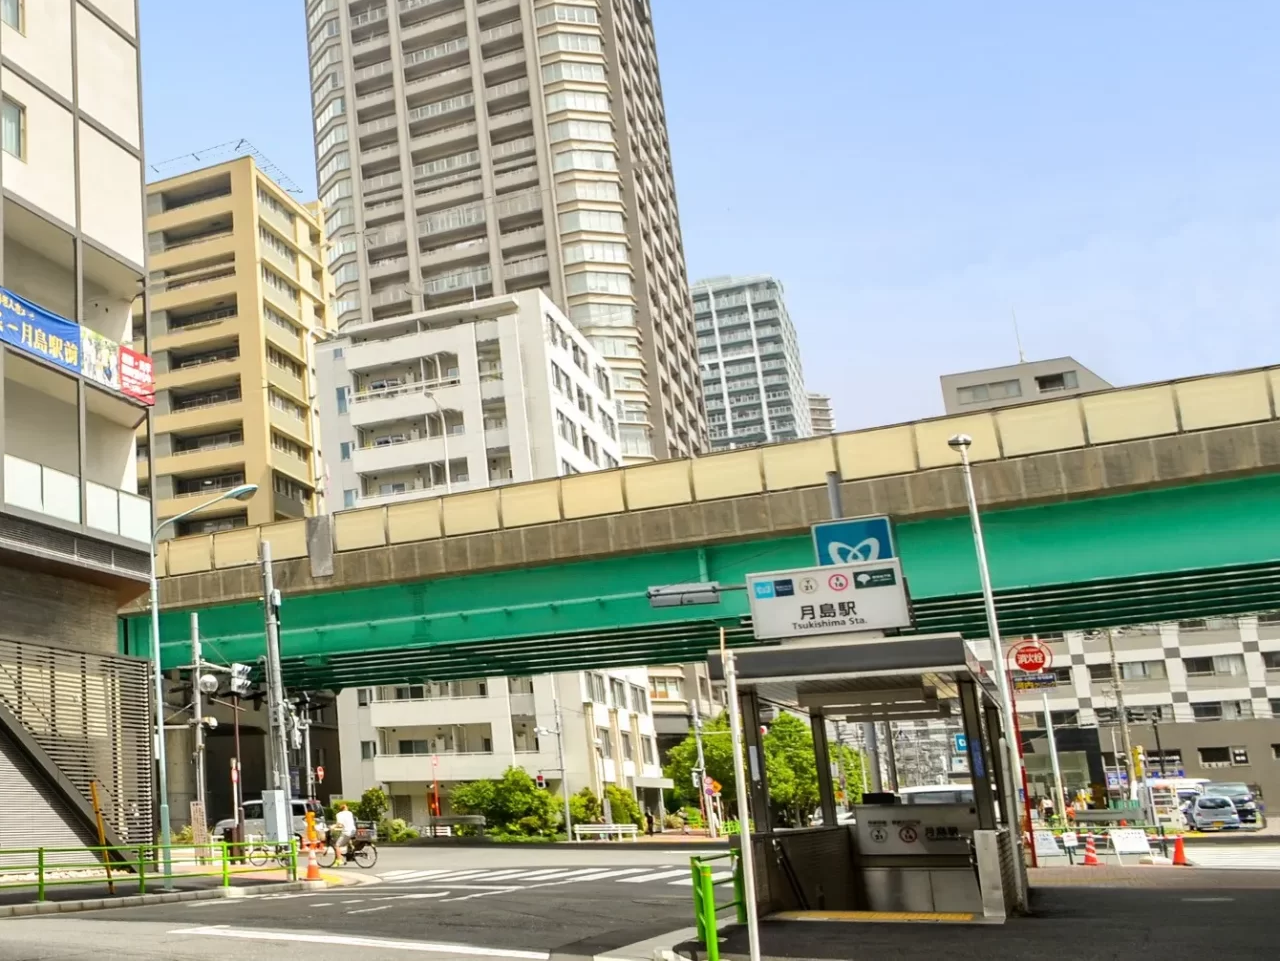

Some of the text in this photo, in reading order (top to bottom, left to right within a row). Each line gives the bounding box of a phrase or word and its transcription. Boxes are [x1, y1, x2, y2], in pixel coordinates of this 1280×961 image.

[800, 601, 858, 621] 月島駅
[792, 617, 868, 630] Tsukishima Sta.
